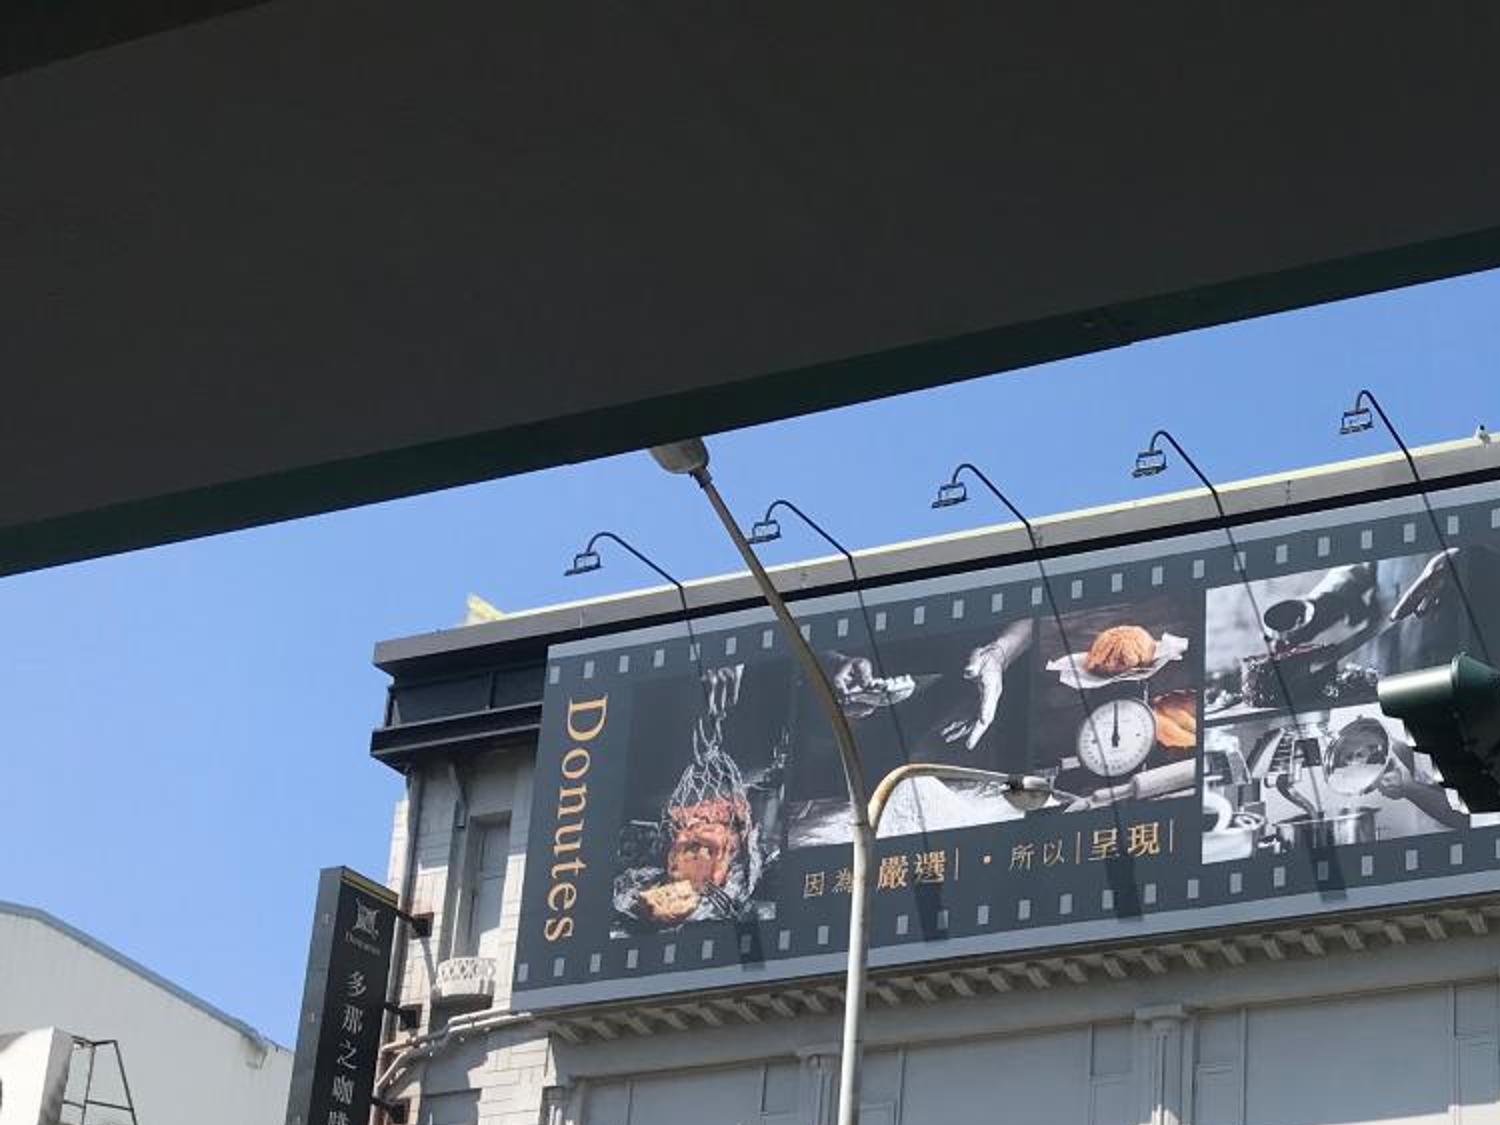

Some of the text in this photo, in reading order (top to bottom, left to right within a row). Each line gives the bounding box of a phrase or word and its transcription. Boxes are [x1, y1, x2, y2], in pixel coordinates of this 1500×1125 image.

[543, 694, 608, 942] Donutes
[877, 849, 945, 891] 嚴選
[1009, 839, 1065, 871] 所以
[1088, 821, 1161, 862] 呈現
